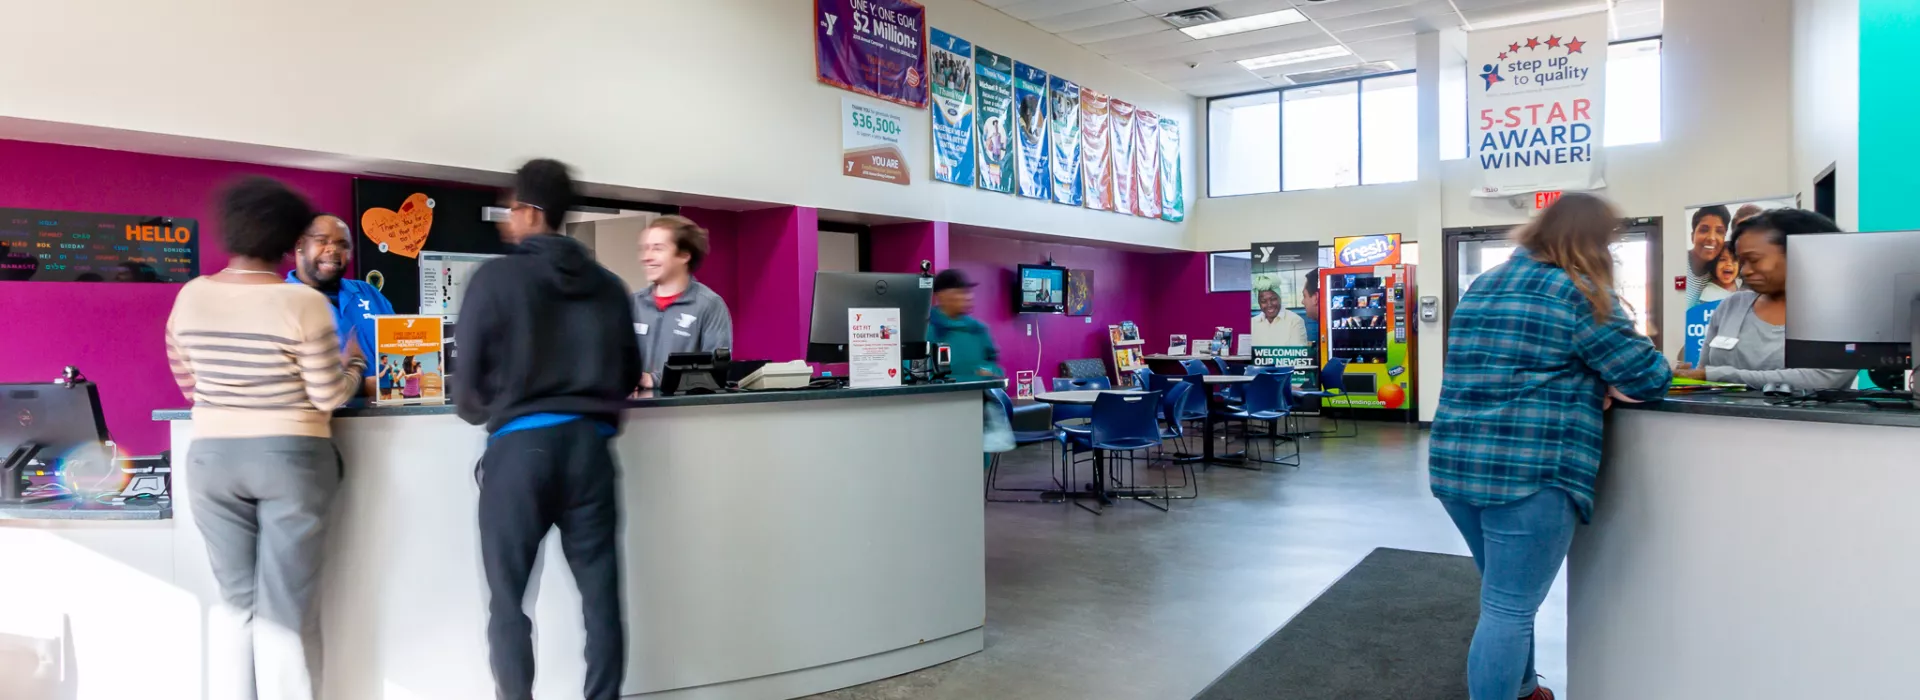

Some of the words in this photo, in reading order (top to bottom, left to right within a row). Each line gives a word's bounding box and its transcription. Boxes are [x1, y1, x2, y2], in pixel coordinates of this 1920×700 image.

[878, 6, 896, 23] ONE
[853, 10, 870, 34] $2
[873, 18, 918, 49] Million+
[1508, 60, 1541, 73] step
[1548, 56, 1568, 70] up
[1514, 75, 1529, 86] to
[1534, 66, 1589, 86] quality
[852, 111, 902, 135] $36,500+
[1480, 98, 1592, 130] 5-STAR
[1480, 123, 1592, 151] AWARD
[872, 155, 886, 168] YOU
[886, 160, 899, 169] ARE
[1480, 143, 1592, 170] WINNER!
[1535, 191, 1562, 209] EXIT
[125, 224, 190, 243] HELLO
[1254, 348, 1308, 357] WELCOMING
[1254, 357, 1274, 366] OUR
[1275, 357, 1313, 367] NEWEST
